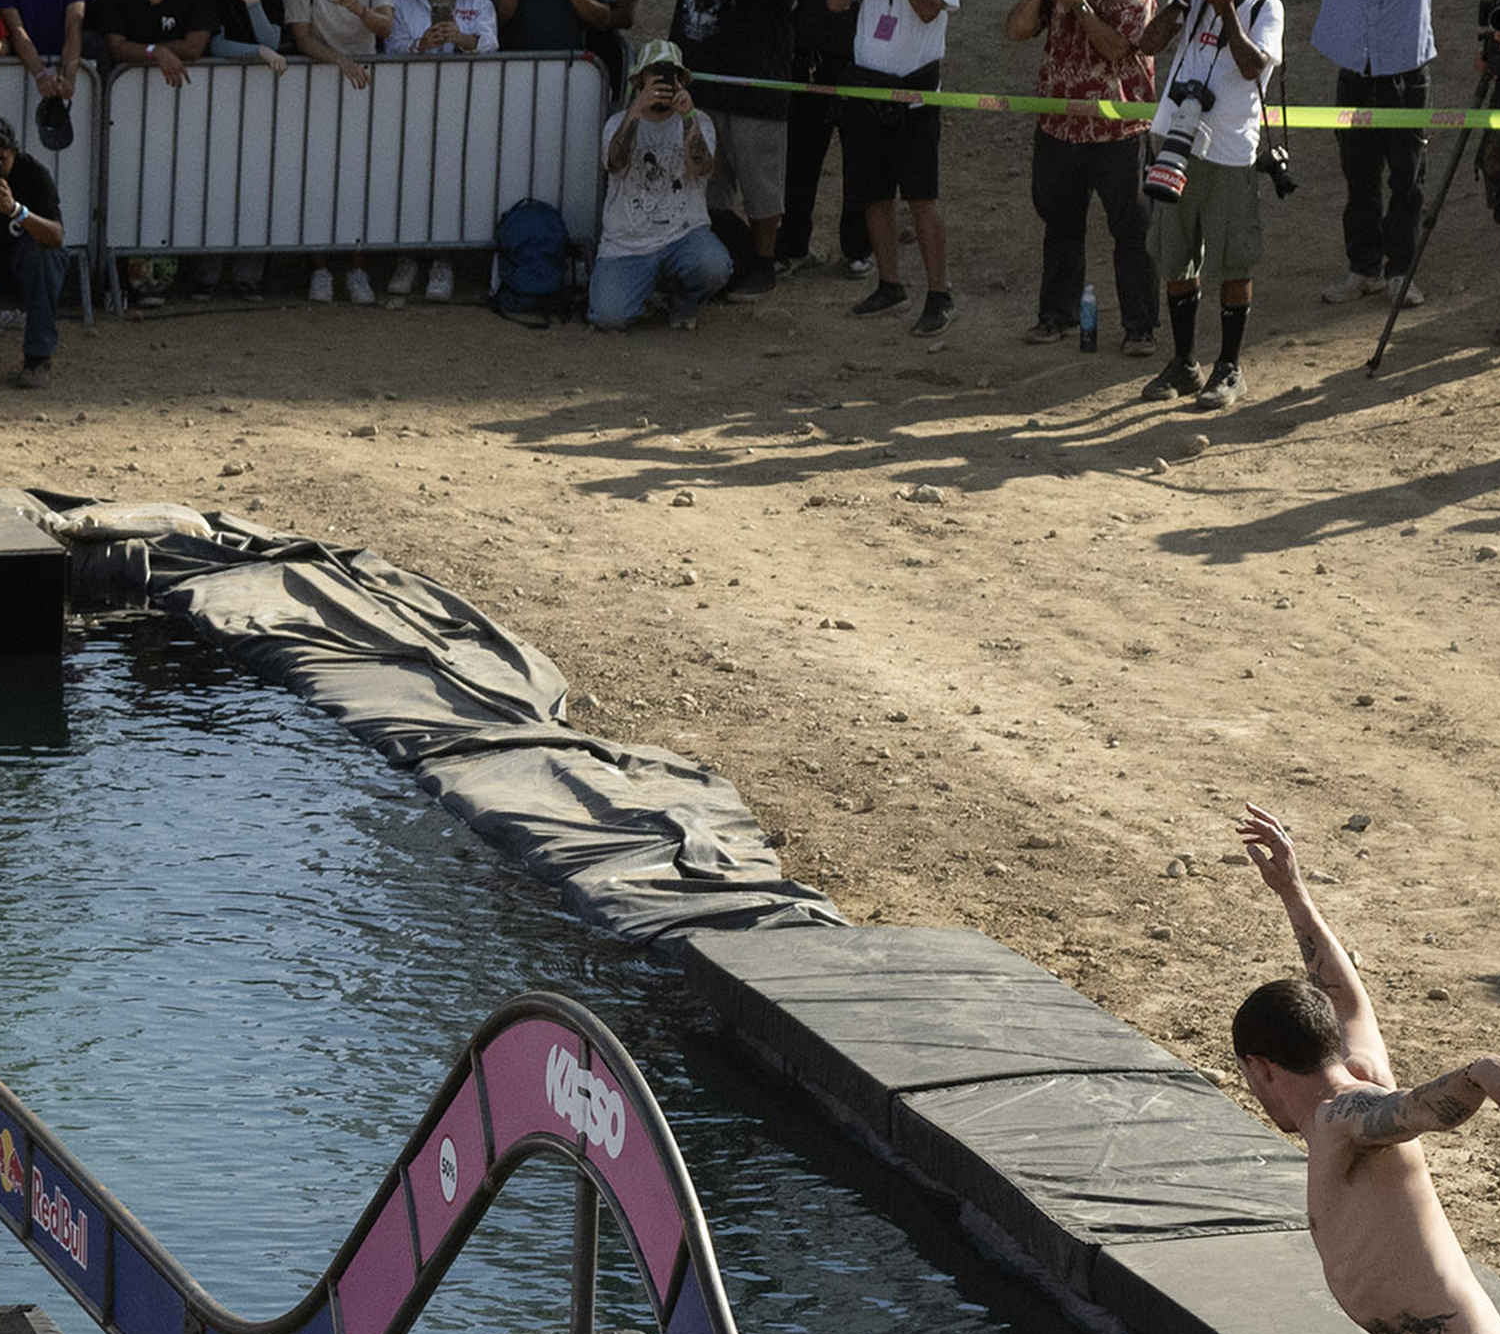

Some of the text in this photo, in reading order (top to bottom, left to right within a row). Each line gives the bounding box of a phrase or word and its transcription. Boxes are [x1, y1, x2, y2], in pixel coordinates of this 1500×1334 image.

[439, 1158, 458, 1185] 50%
[31, 1166, 90, 1271] Red Bull
